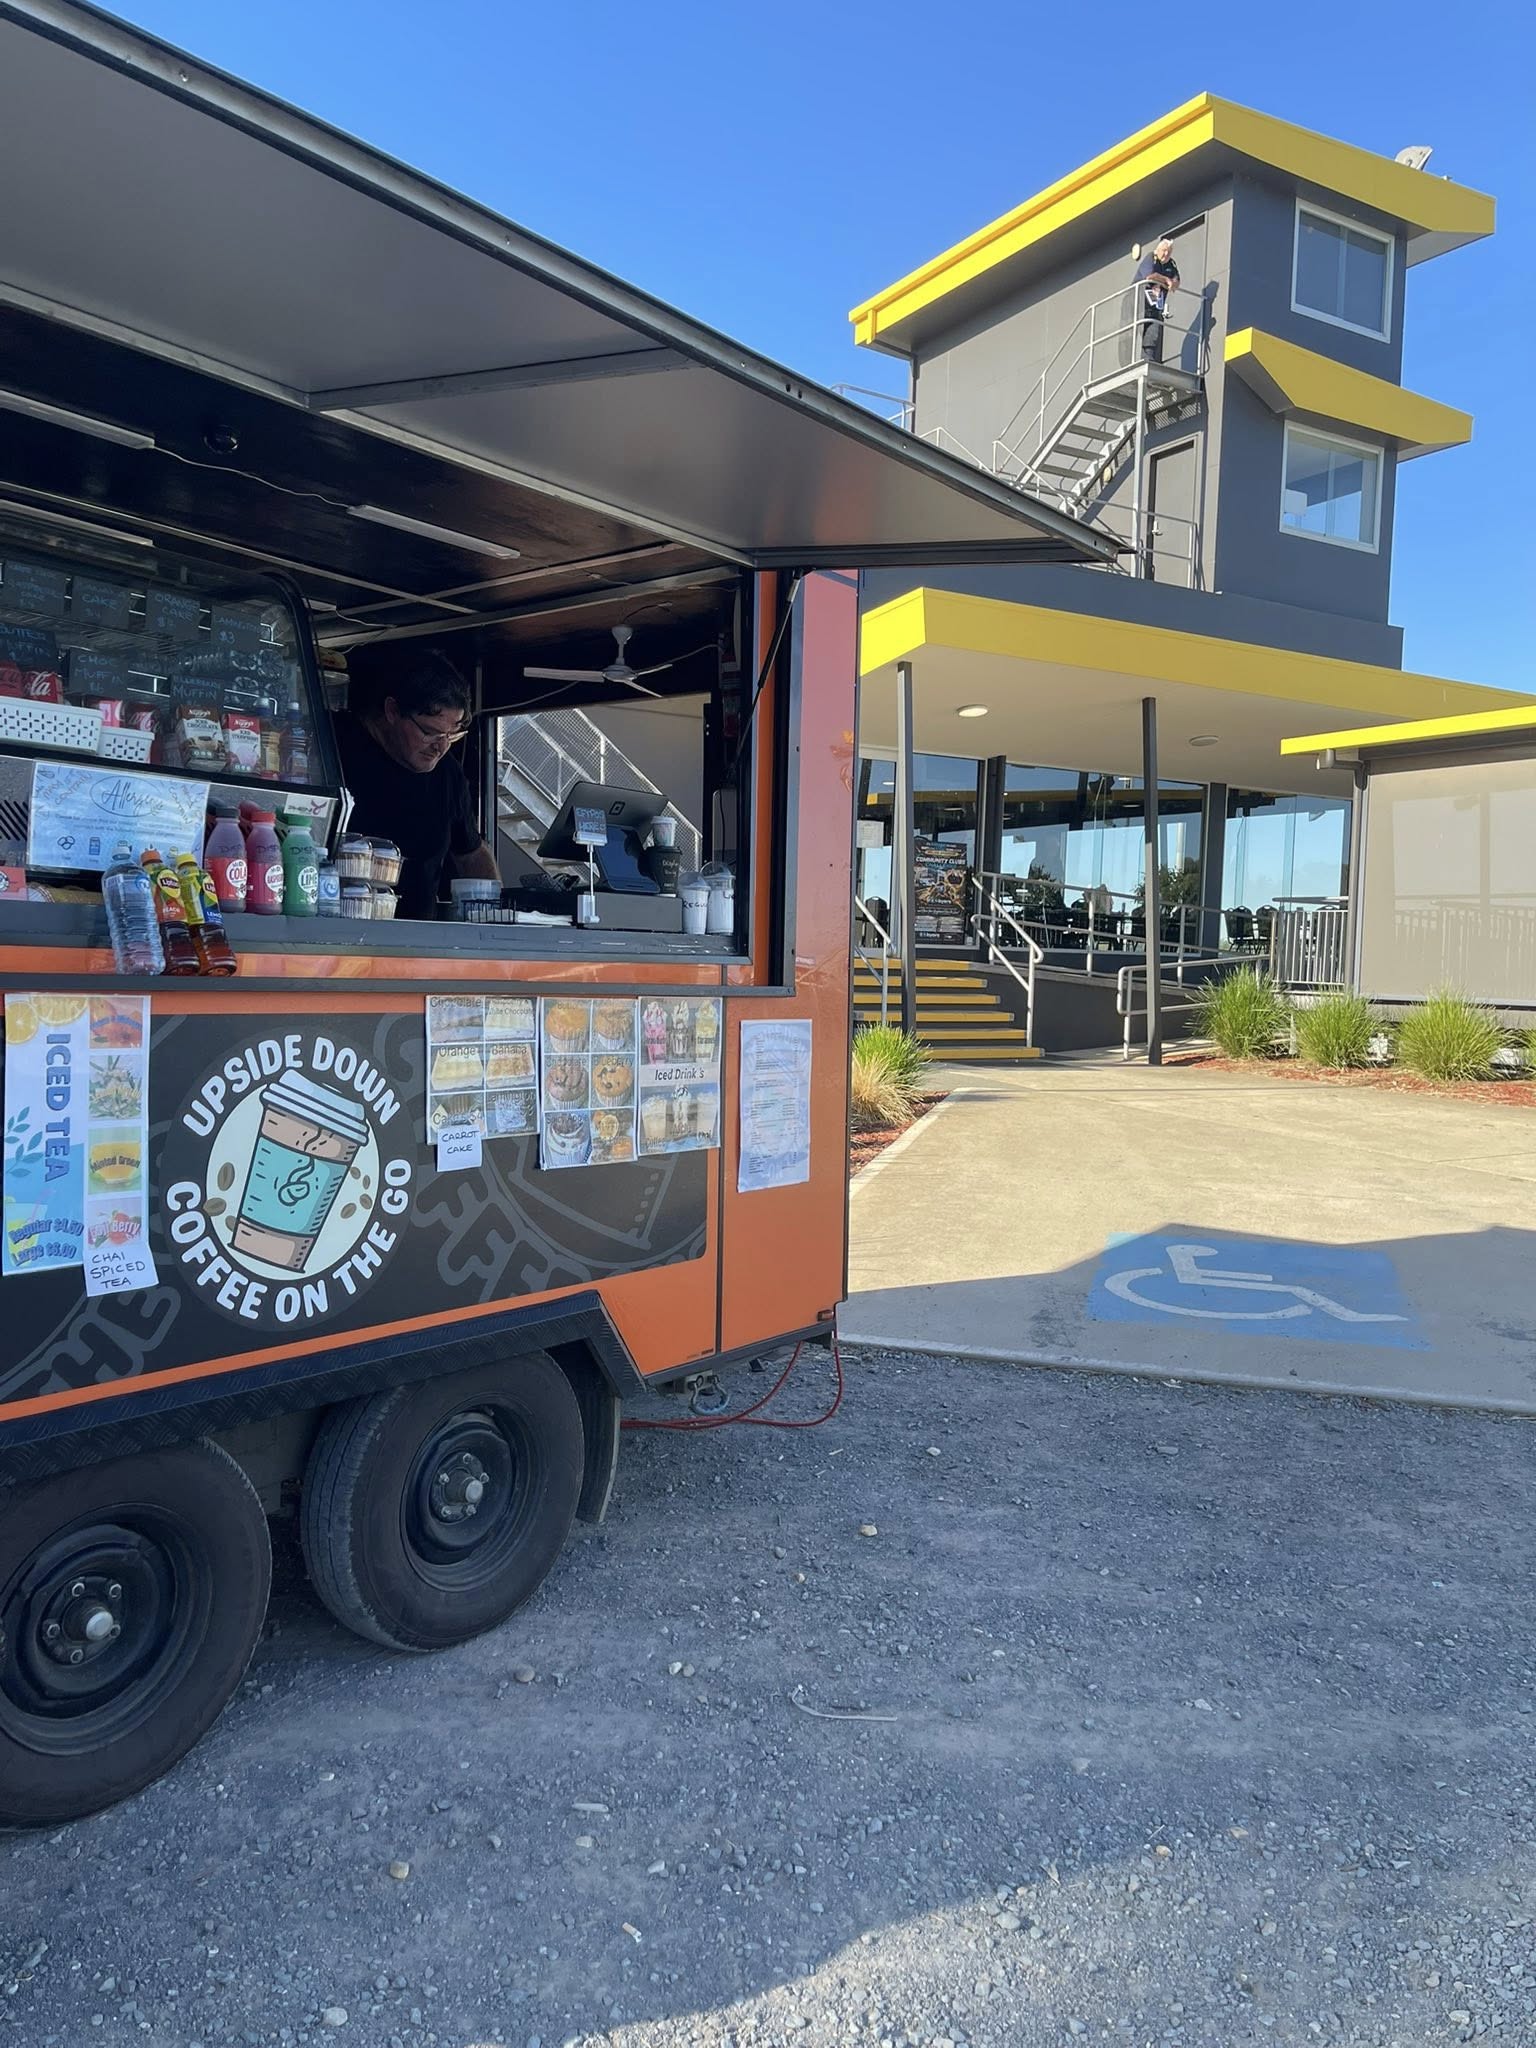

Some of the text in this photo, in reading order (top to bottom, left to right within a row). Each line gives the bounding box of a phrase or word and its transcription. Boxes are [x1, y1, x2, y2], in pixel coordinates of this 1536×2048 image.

[81, 593, 118, 610] CAKE
[154, 593, 201, 609] ORANGE
[161, 606, 193, 621] CAKE
[219, 630, 236, 645] $3
[77, 655, 113, 667] CHOC
[173, 685, 218, 700] MUFFIN
[915, 856, 948, 864] COMMUNITY
[430, 996, 482, 1009] Chocolate
[439, 1046, 477, 1060] Orange
[491, 1044, 528, 1056] Banana
[654, 1068, 674, 1081] Iced
[674, 1067, 697, 1080] Drink
[183, 1034, 401, 1137] UPSIDE DOWN
[45, 1033, 71, 1183] ICED TEA
[441, 1130, 480, 1143] CARROT
[447, 1144, 473, 1154] CAKE
[8, 1219, 53, 1245] Regular
[111, 1220, 141, 1237] Berry
[166, 1181, 268, 1320] COFFEE
[275, 1279, 329, 1323] ON
[332, 1221, 397, 1296] THE
[381, 1158, 412, 1215] GO
[11, 1244, 44, 1267] Large
[91, 1251, 126, 1264] CHAI
[90, 1260, 146, 1280] SPICED
[100, 1276, 132, 1290] TEA
